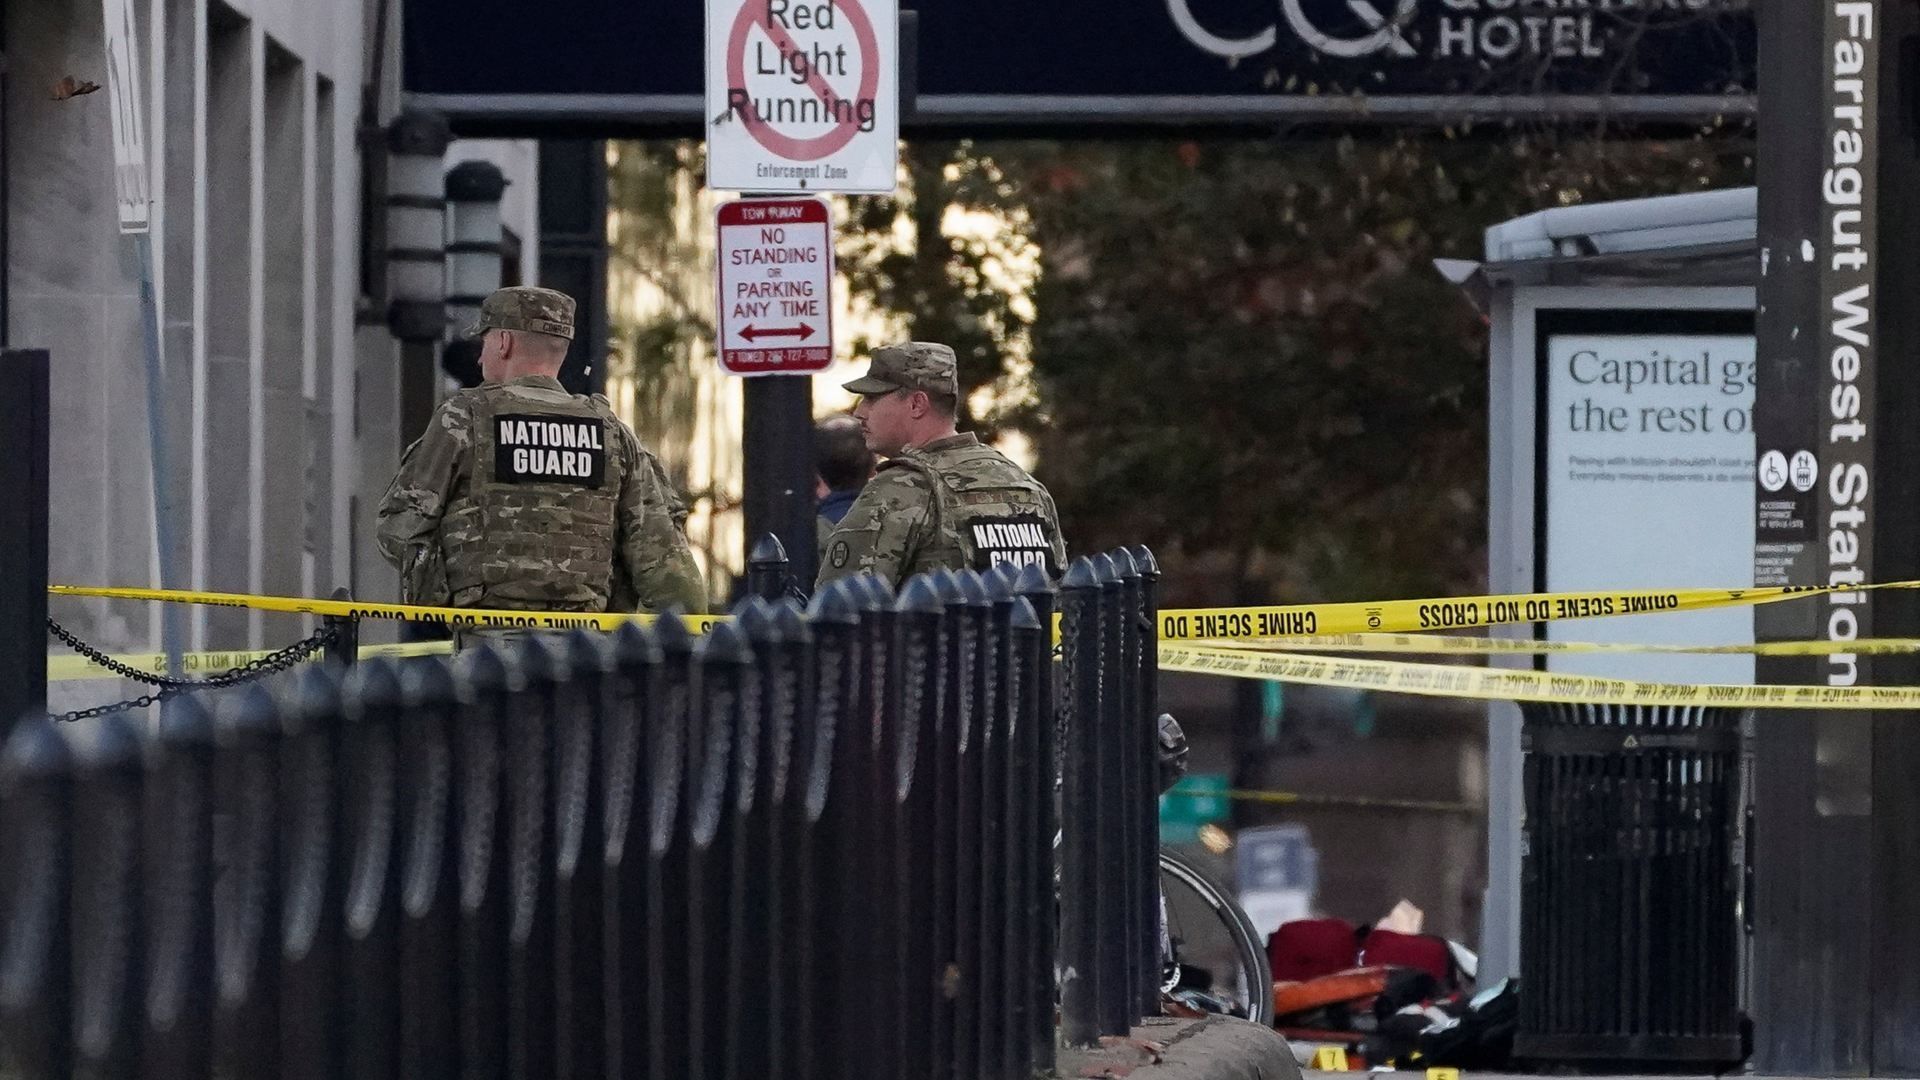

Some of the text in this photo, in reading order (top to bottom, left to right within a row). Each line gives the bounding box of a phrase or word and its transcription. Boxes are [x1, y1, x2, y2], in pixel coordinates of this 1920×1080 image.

[767, 0, 834, 30] Red
[1439, 17, 1603, 57] HOTEL
[757, 41, 847, 85] Light
[728, 88, 876, 132] Running
[757, 162, 848, 180] Enforcement Zone
[741, 207, 766, 220] TOW
[761, 228, 785, 245] NO
[731, 247, 817, 266] STANDING
[767, 268, 782, 278] OR
[737, 281, 813, 299] PARKING
[733, 300, 819, 319] ANY TIME
[1823, 1, 1873, 686] Farragut West Station
[1569, 351, 1711, 395] Capital
[1569, 398, 1628, 433] the
[1639, 401, 1713, 433] rest
[500, 420, 603, 450] NATIONAL
[513, 448, 593, 477] GUARD
[973, 523, 1050, 549] NATIONAL
[1419, 602, 1479, 628] CROSS
[1485, 600, 1519, 624] NOT
[1526, 599, 1549, 621] DO
[1557, 597, 1614, 619] SCENE
[1164, 611, 1317, 638] CRIME SCENE DO
